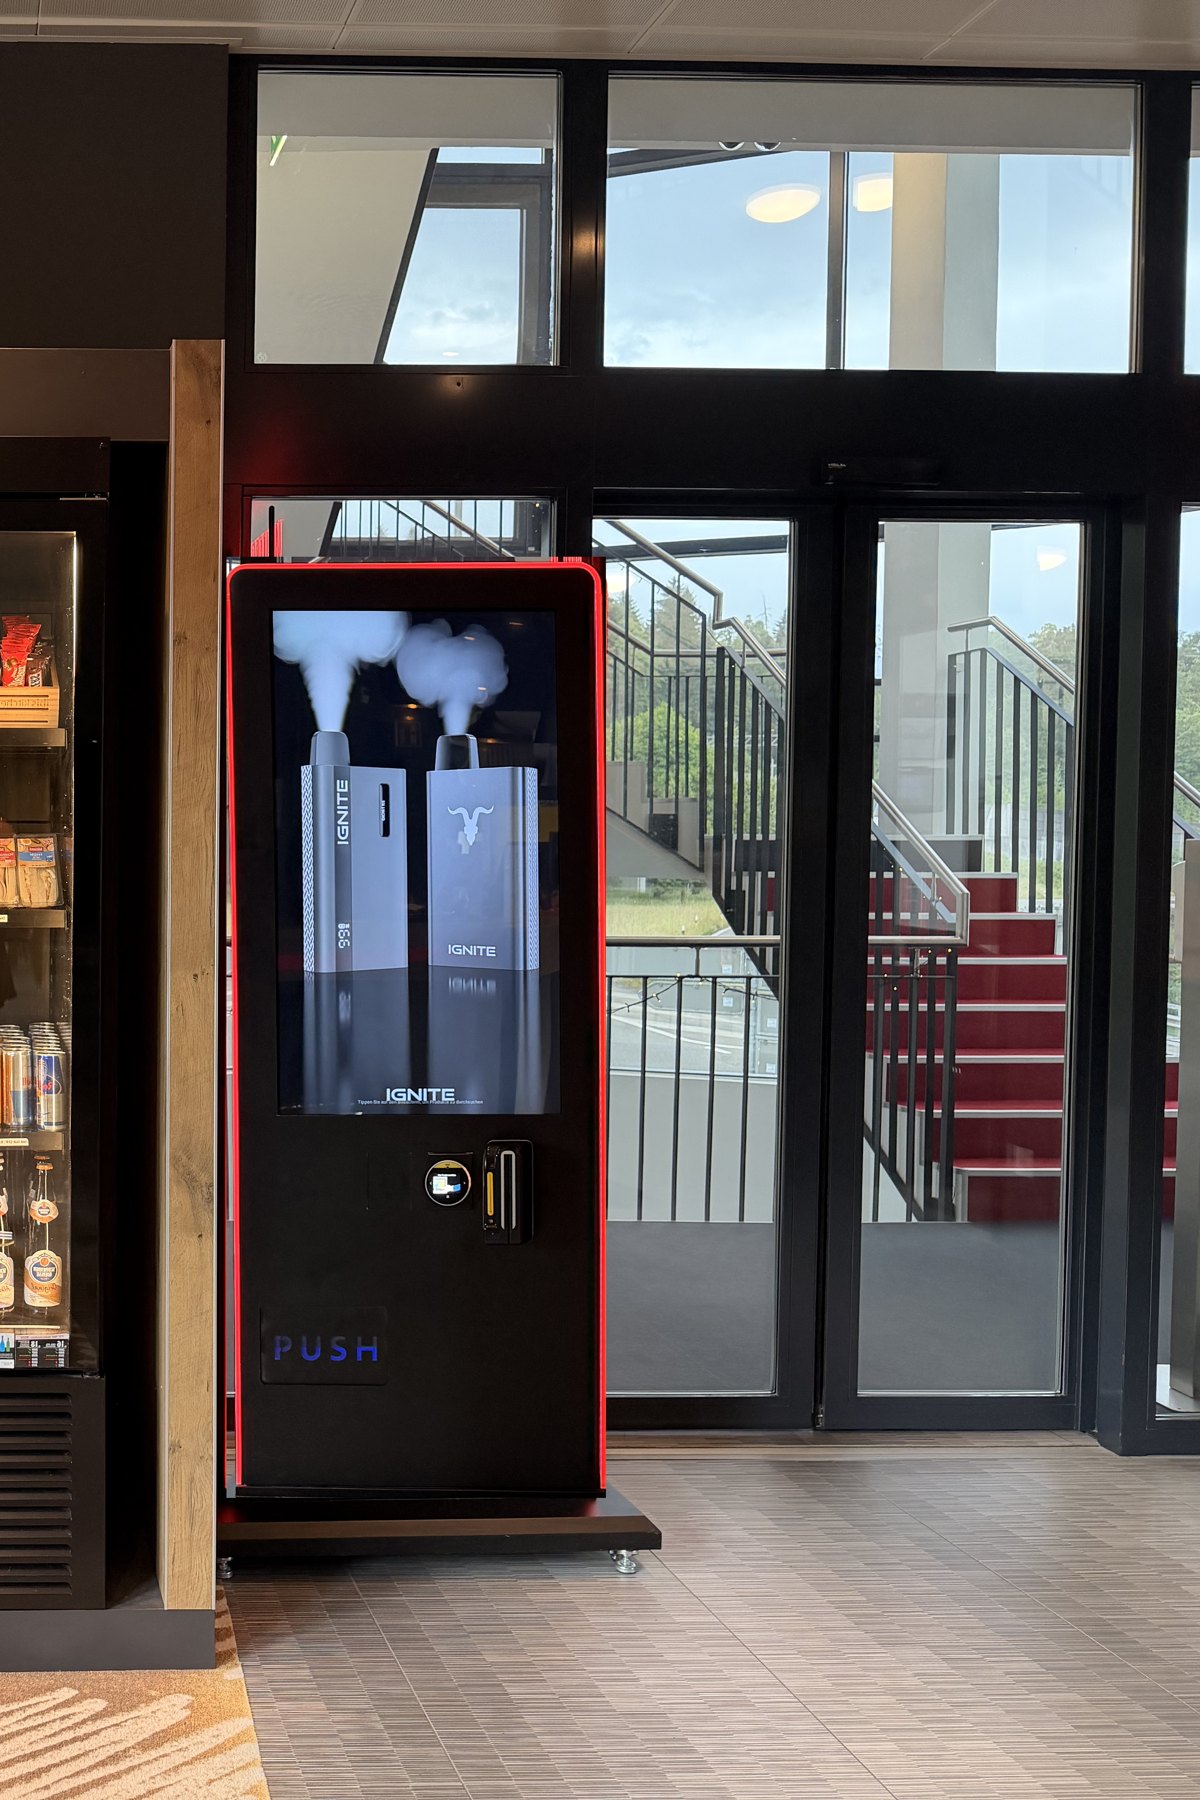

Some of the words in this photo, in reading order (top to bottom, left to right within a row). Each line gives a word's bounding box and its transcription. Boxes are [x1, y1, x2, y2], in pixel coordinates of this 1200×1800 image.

[337, 779, 349, 845] IGNITE
[448, 944, 496, 957] IGNITE
[386, 1088, 455, 1101] IGNITE
[274, 1336, 378, 1362] PUSH
